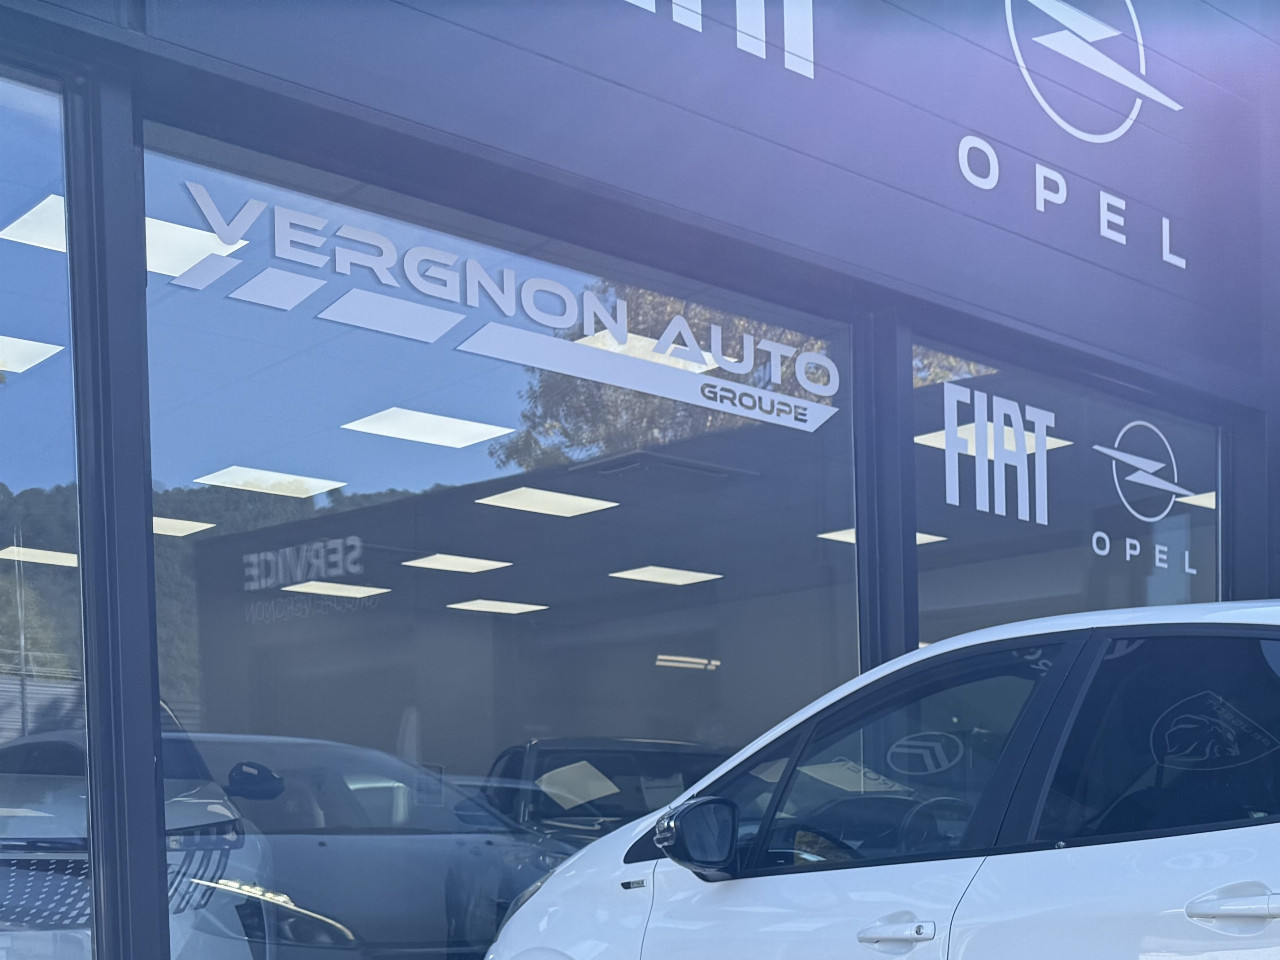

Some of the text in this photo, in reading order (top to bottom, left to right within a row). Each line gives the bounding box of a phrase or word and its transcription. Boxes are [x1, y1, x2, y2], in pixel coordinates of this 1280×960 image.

[958, 135, 1187, 270] OPEL
[184, 181, 840, 397] VERGNON AUTO
[700, 383, 809, 424] GROUPE
[943, 382, 1055, 526] FIAT
[1091, 531, 1197, 574] OPEL
